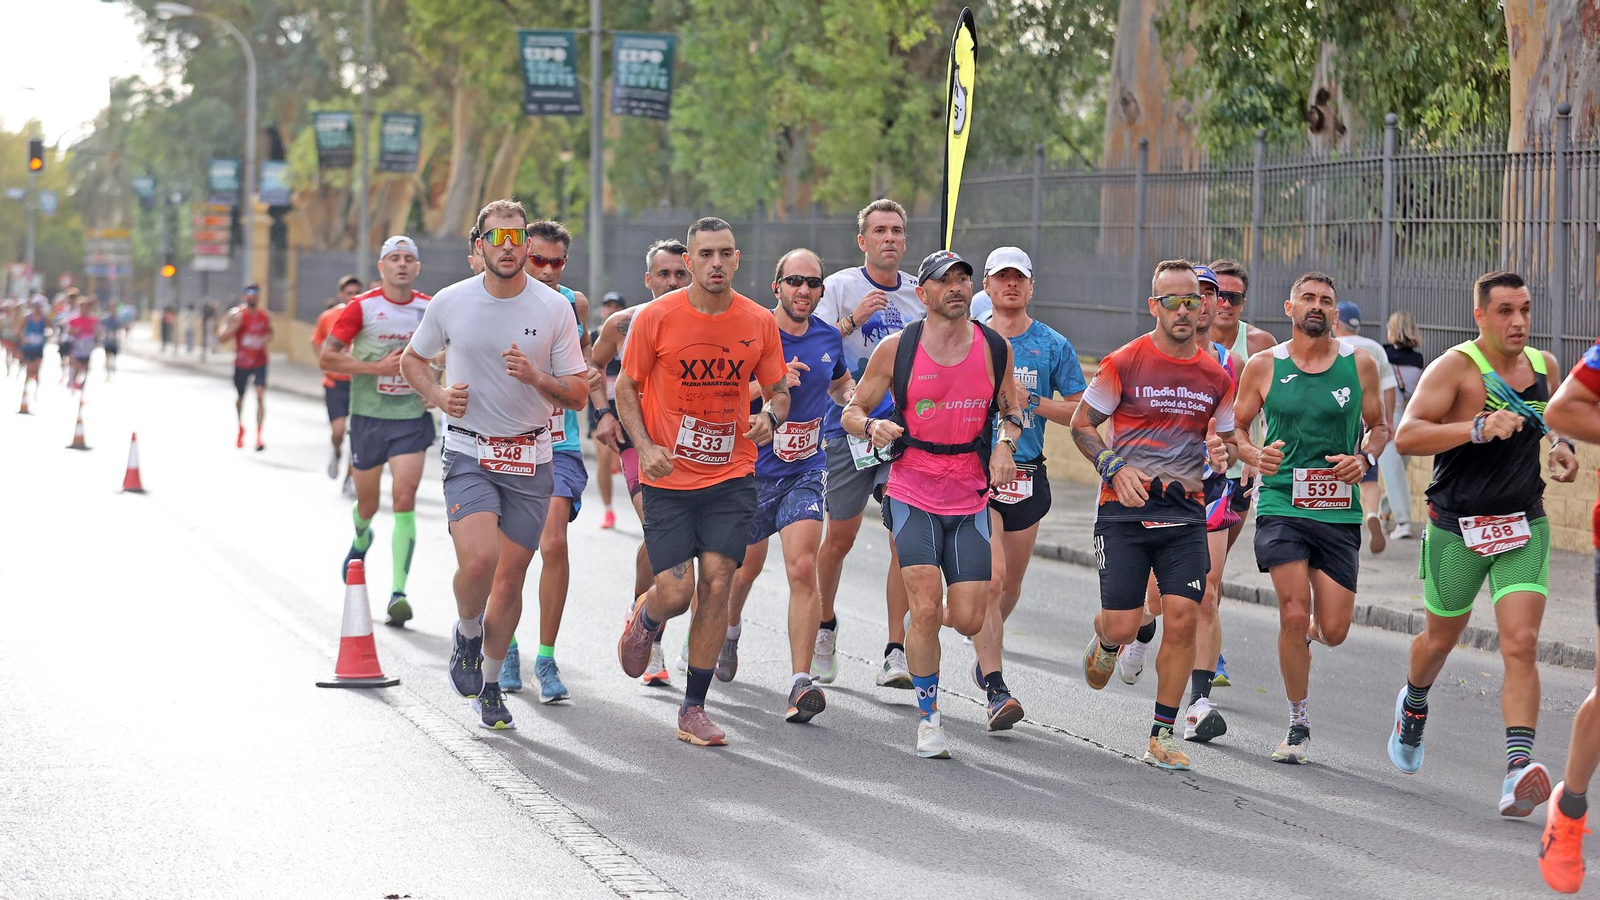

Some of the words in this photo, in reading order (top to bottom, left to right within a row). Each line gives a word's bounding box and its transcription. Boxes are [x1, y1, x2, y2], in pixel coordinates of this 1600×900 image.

[1177, 386, 1214, 405] Maratón
[1150, 399, 1176, 408] Ciudad
[1187, 400, 1207, 412] Cádiz
[691, 432, 723, 452] 533
[787, 433, 811, 450] 459
[492, 446, 522, 461] 548
[1307, 482, 1338, 497] 539
[1480, 525, 1514, 541] 488
